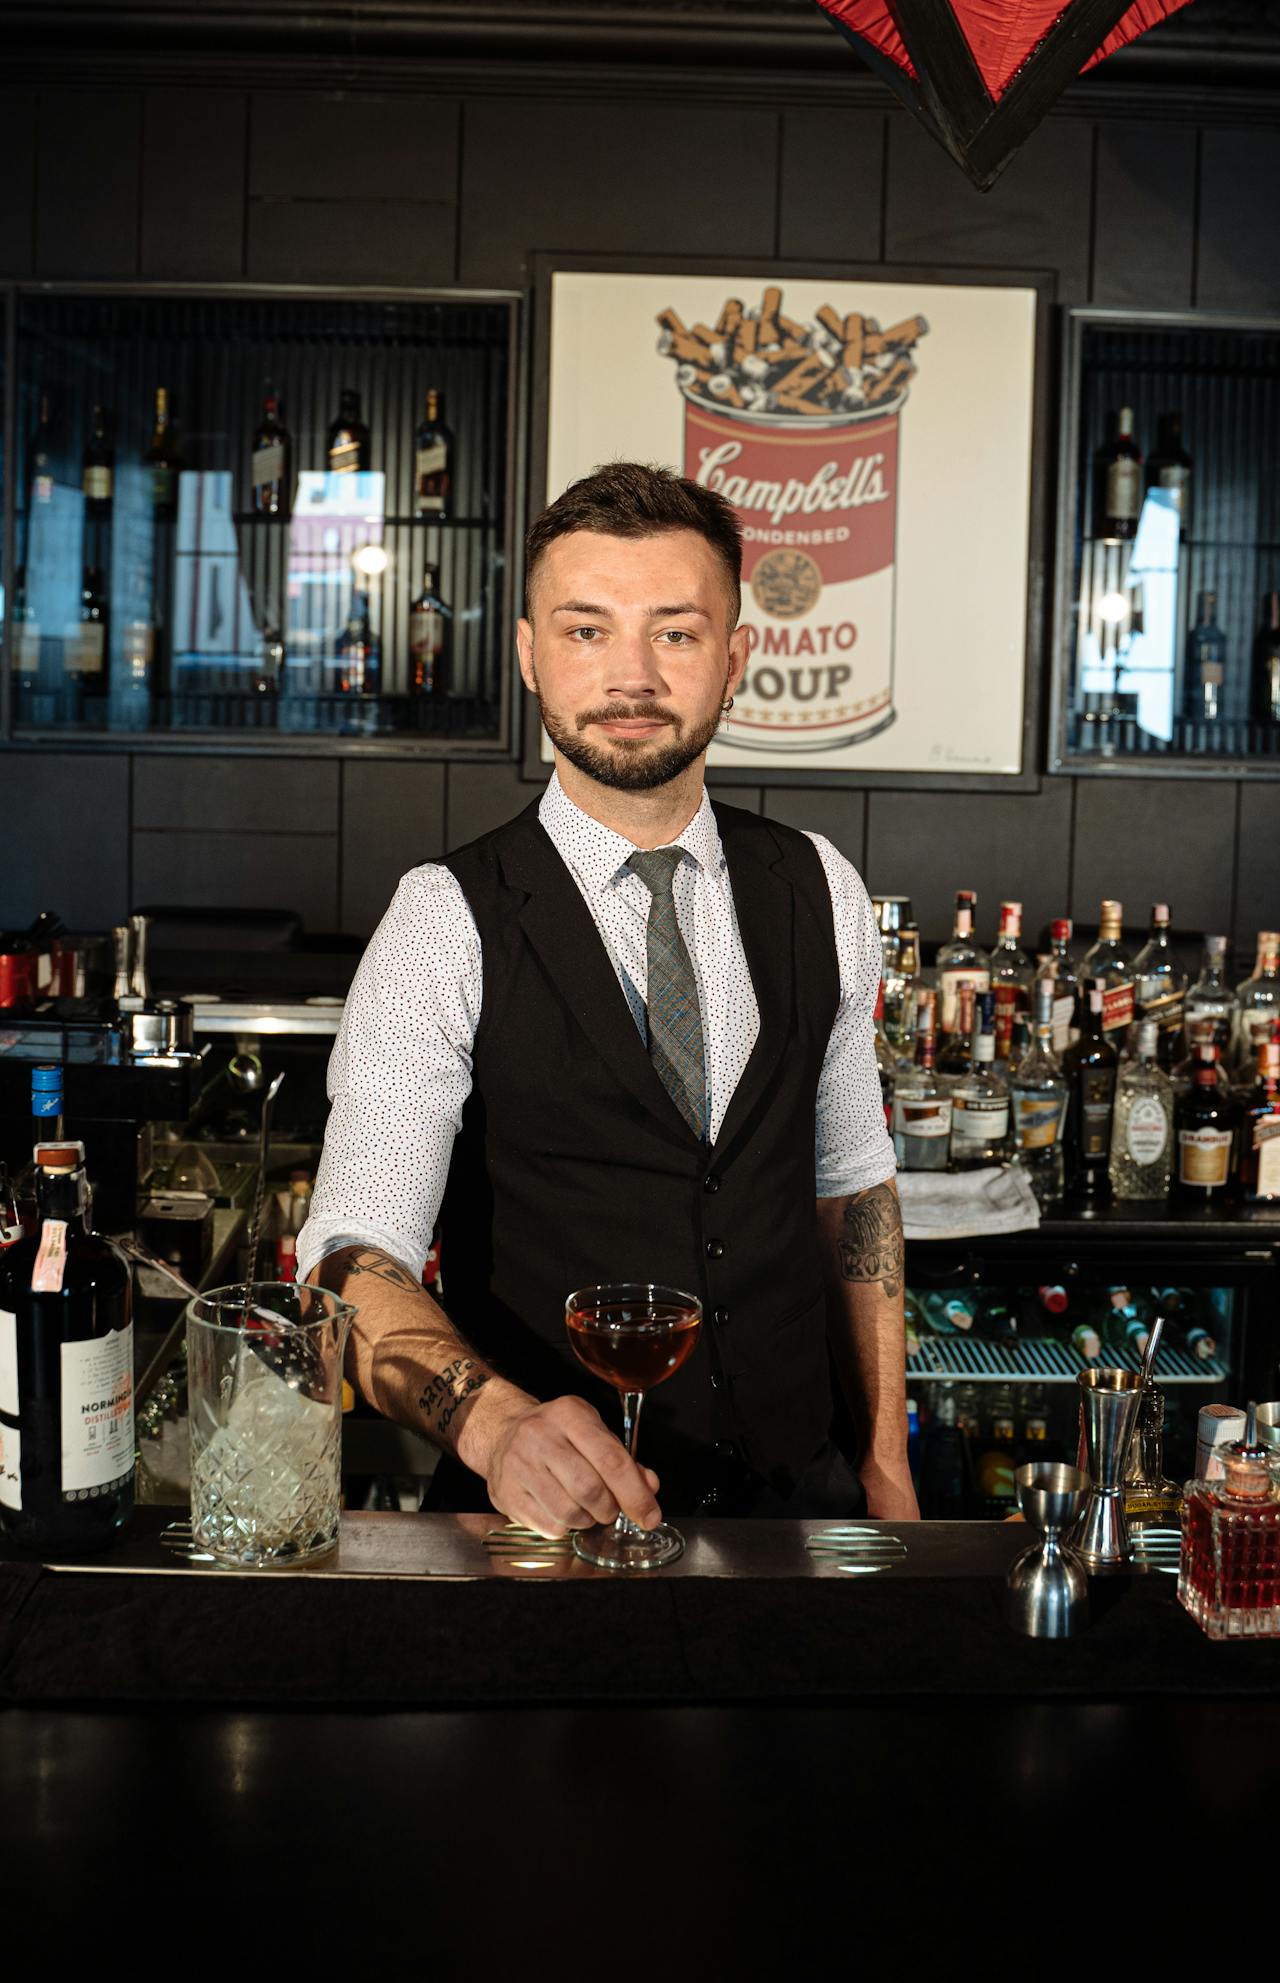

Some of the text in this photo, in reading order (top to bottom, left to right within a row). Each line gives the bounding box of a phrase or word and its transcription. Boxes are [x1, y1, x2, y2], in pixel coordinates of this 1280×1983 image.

[696, 441, 889, 525] Campbell's
[743, 526, 850, 545] ONDENSED
[740, 622, 858, 656] OMATO
[735, 664, 852, 702] OUP
